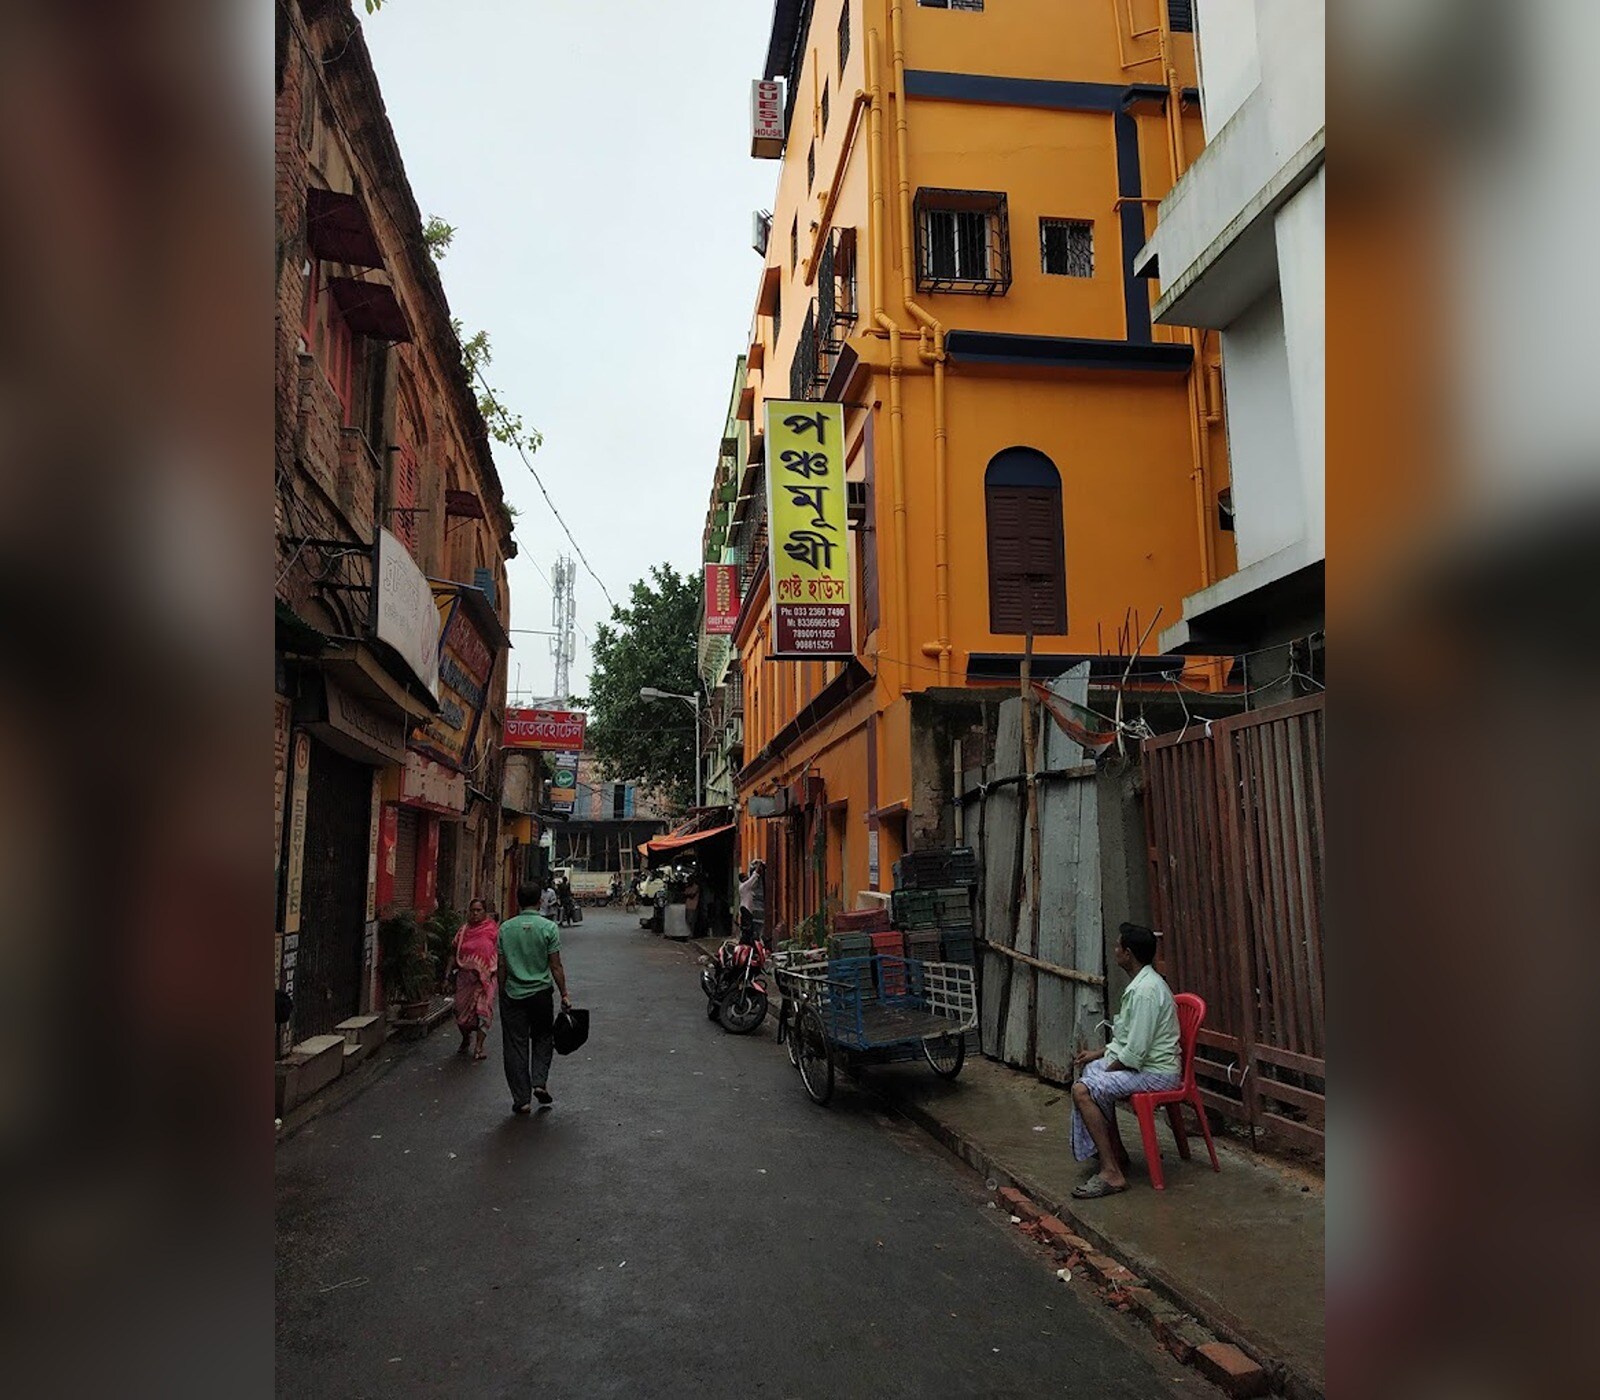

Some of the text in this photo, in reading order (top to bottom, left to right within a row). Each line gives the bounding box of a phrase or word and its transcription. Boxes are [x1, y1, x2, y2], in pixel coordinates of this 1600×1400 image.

[758, 82, 778, 128] GUEST
[755, 128, 782, 137] HOUSE
[778, 572, 845, 601] গেষ্ট হাউস
[793, 607, 807, 616] 033
